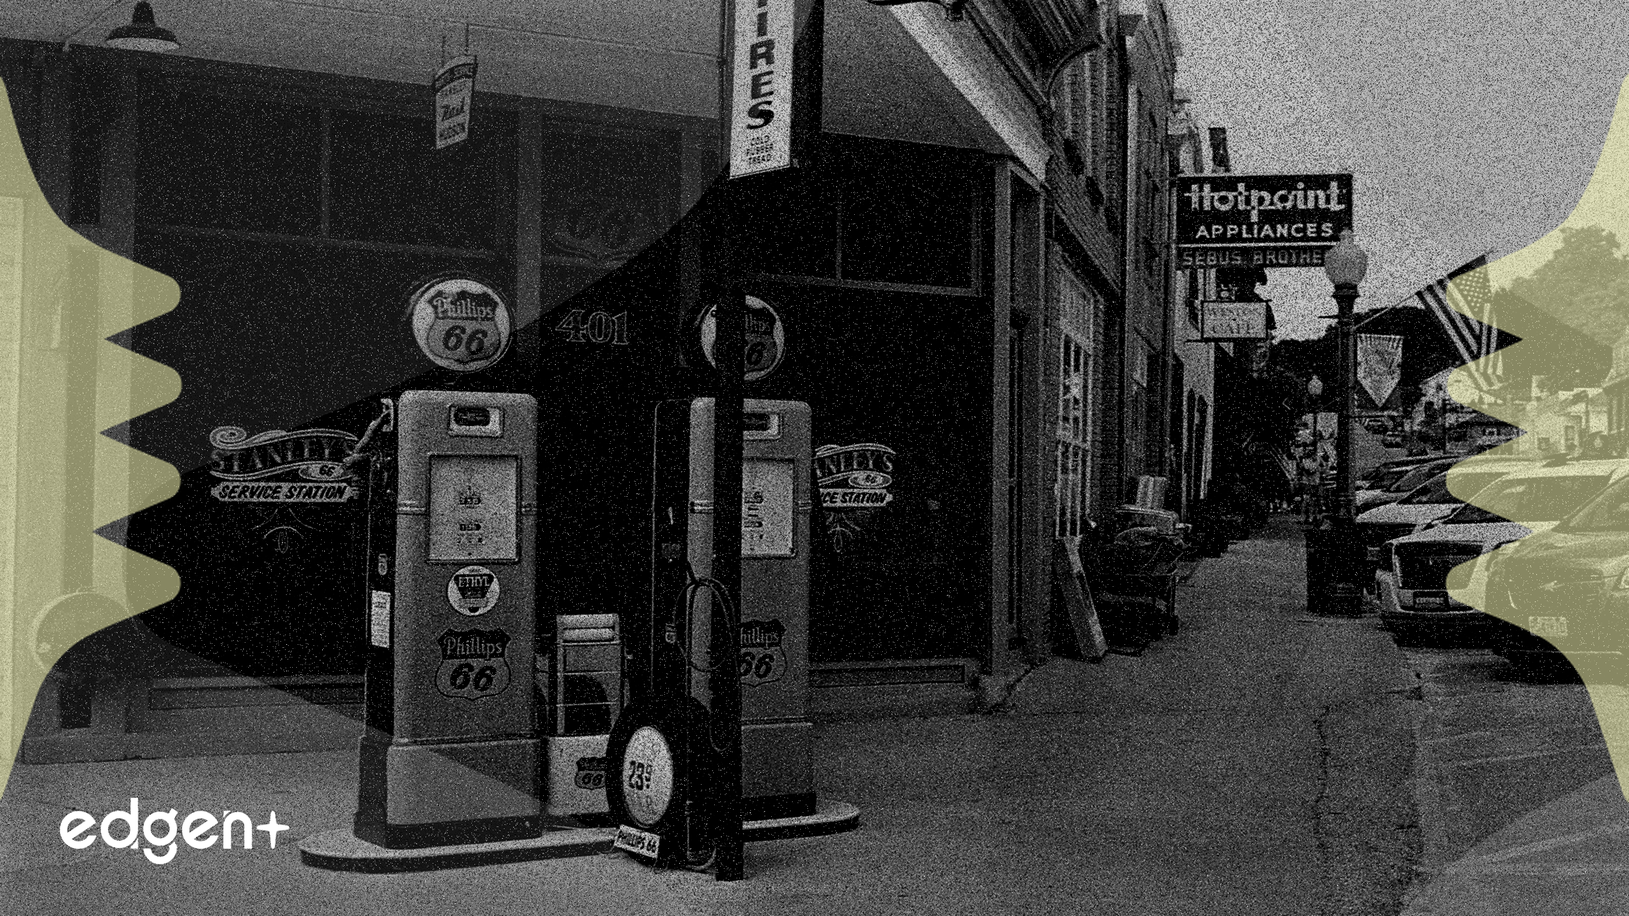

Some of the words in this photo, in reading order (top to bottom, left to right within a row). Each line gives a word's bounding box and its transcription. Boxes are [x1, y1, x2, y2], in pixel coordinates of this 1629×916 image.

[746, 0, 775, 130] IRES
[1184, 181, 1346, 222] Hotpoint
[1195, 223, 1334, 239] APPLIANCES
[1182, 249, 1242, 266] SEBUS
[1253, 249, 1322, 265] BROTHE
[433, 296, 493, 322] Phillips
[554, 309, 630, 346] 401
[443, 325, 488, 355] 66
[746, 341, 764, 367] 6
[319, 464, 336, 477] 66
[218, 485, 283, 499] SERVICE
[285, 485, 348, 499] STATION
[840, 491, 887, 504] STATION
[458, 576, 491, 588] ETHYL
[443, 634, 503, 659] Phillips
[740, 627, 779, 648] hillips
[450, 662, 497, 691] 66
[581, 773, 604, 787] 66
[646, 840, 657, 854] 66
